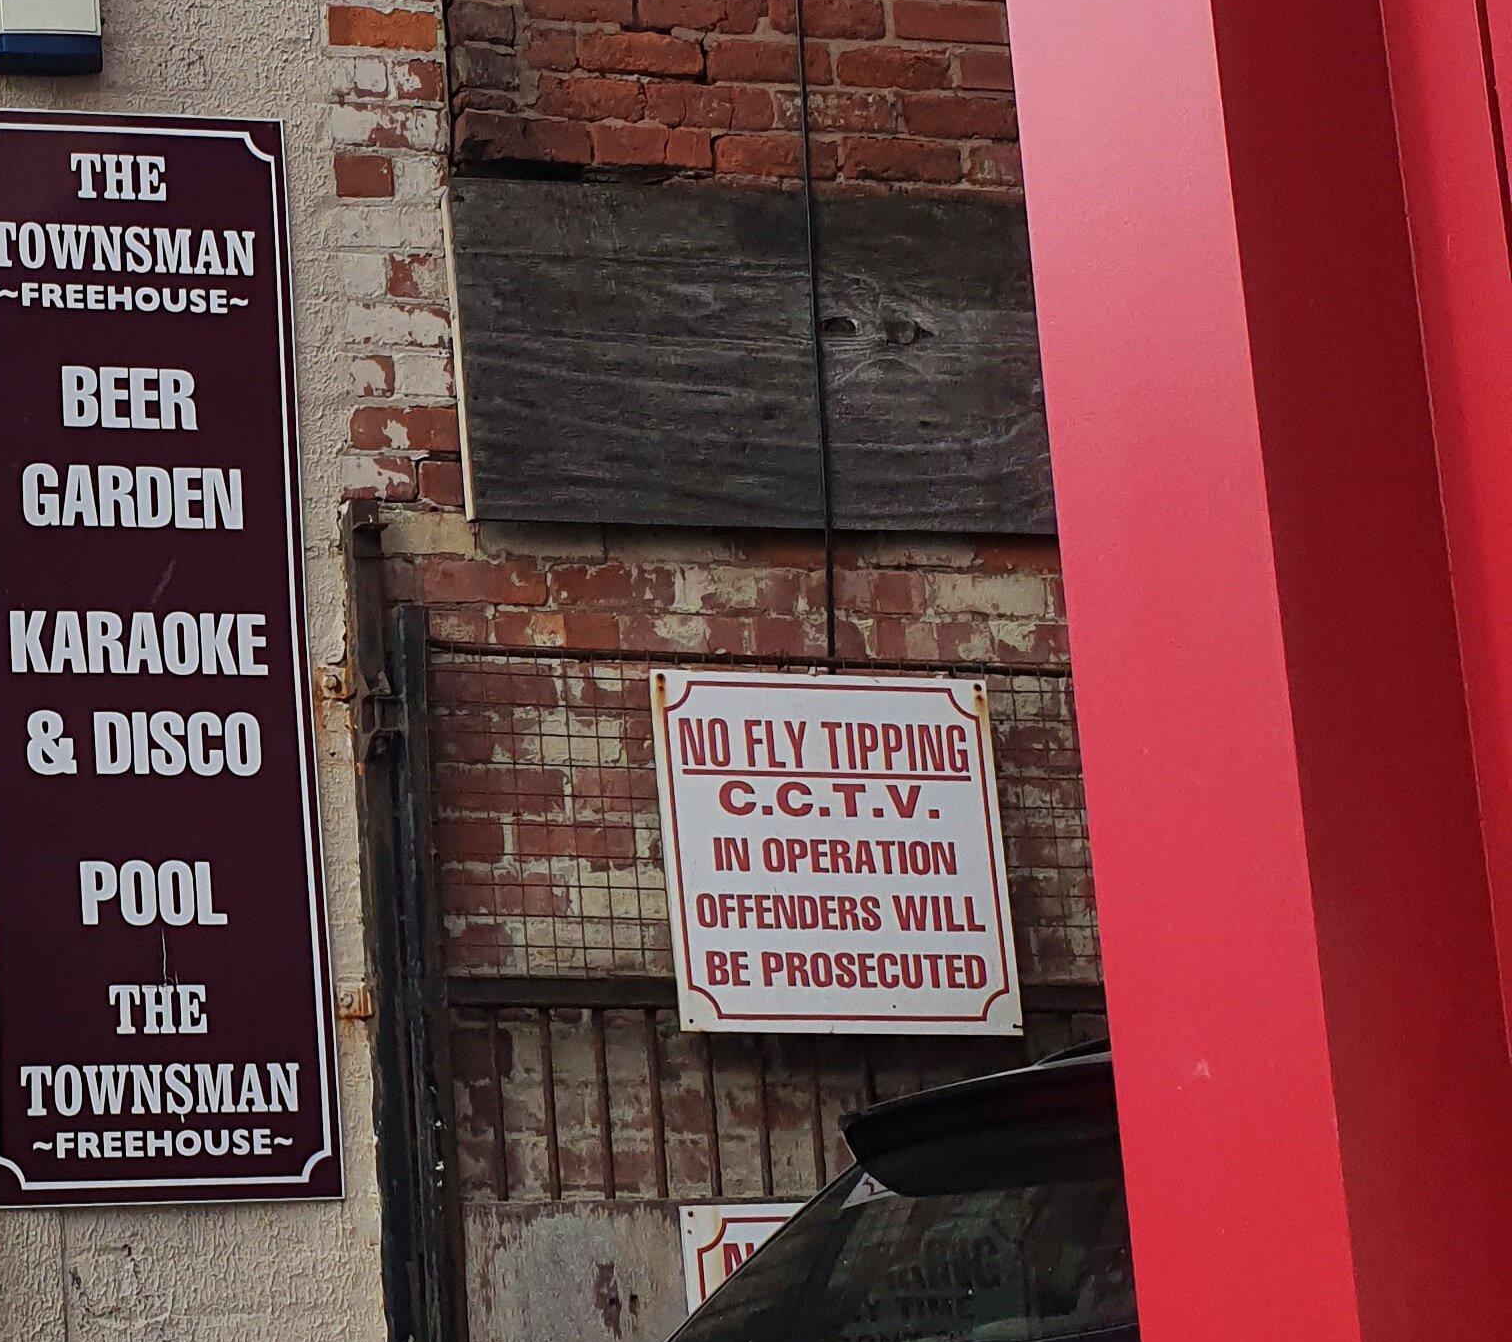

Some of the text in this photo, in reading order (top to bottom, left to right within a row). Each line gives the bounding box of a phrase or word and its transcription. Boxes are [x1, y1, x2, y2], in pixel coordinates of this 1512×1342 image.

[70, 152, 168, 203] THE
[61, 364, 200, 432] BEER
[21, 462, 245, 531] GARDEN
[9, 610, 269, 677] KARAOKE
[26, 709, 263, 777] & DISCO
[678, 718, 971, 774] NO FLY TIPPING
[718, 779, 941, 820] C.C.T.V.
[712, 837, 958, 876] IN OPERATION
[79, 859, 229, 927] POOL
[695, 892, 987, 933] OFFENDERS WILL
[705, 950, 989, 990] BE PROSECUTED
[108, 984, 209, 1035] THE
[20, 1061, 300, 1118] TOWNSMAN
